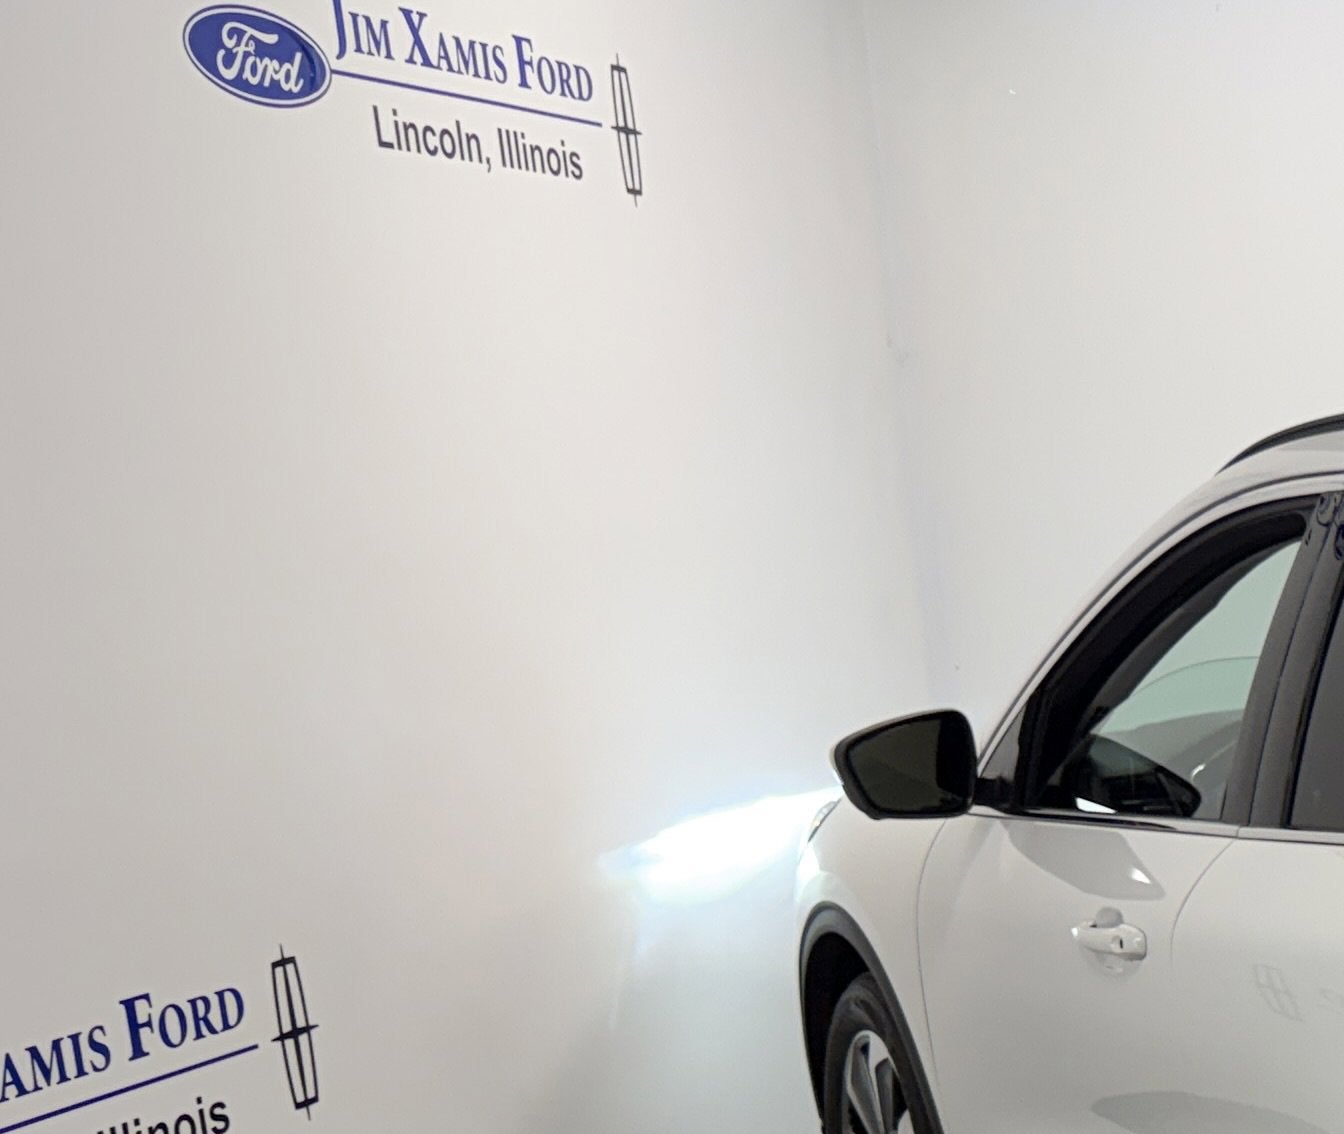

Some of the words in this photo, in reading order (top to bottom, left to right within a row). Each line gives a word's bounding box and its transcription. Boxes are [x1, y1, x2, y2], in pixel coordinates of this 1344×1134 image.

[217, 21, 304, 93] Ford
[332, 0, 395, 60] JIM
[398, 6, 508, 85] XAMIS
[512, 34, 593, 102] FORD
[372, 105, 492, 172] Lincoln,
[498, 127, 583, 180] Illinois
[0, 1025, 112, 1102] AMIS
[119, 987, 245, 1062] FORD
